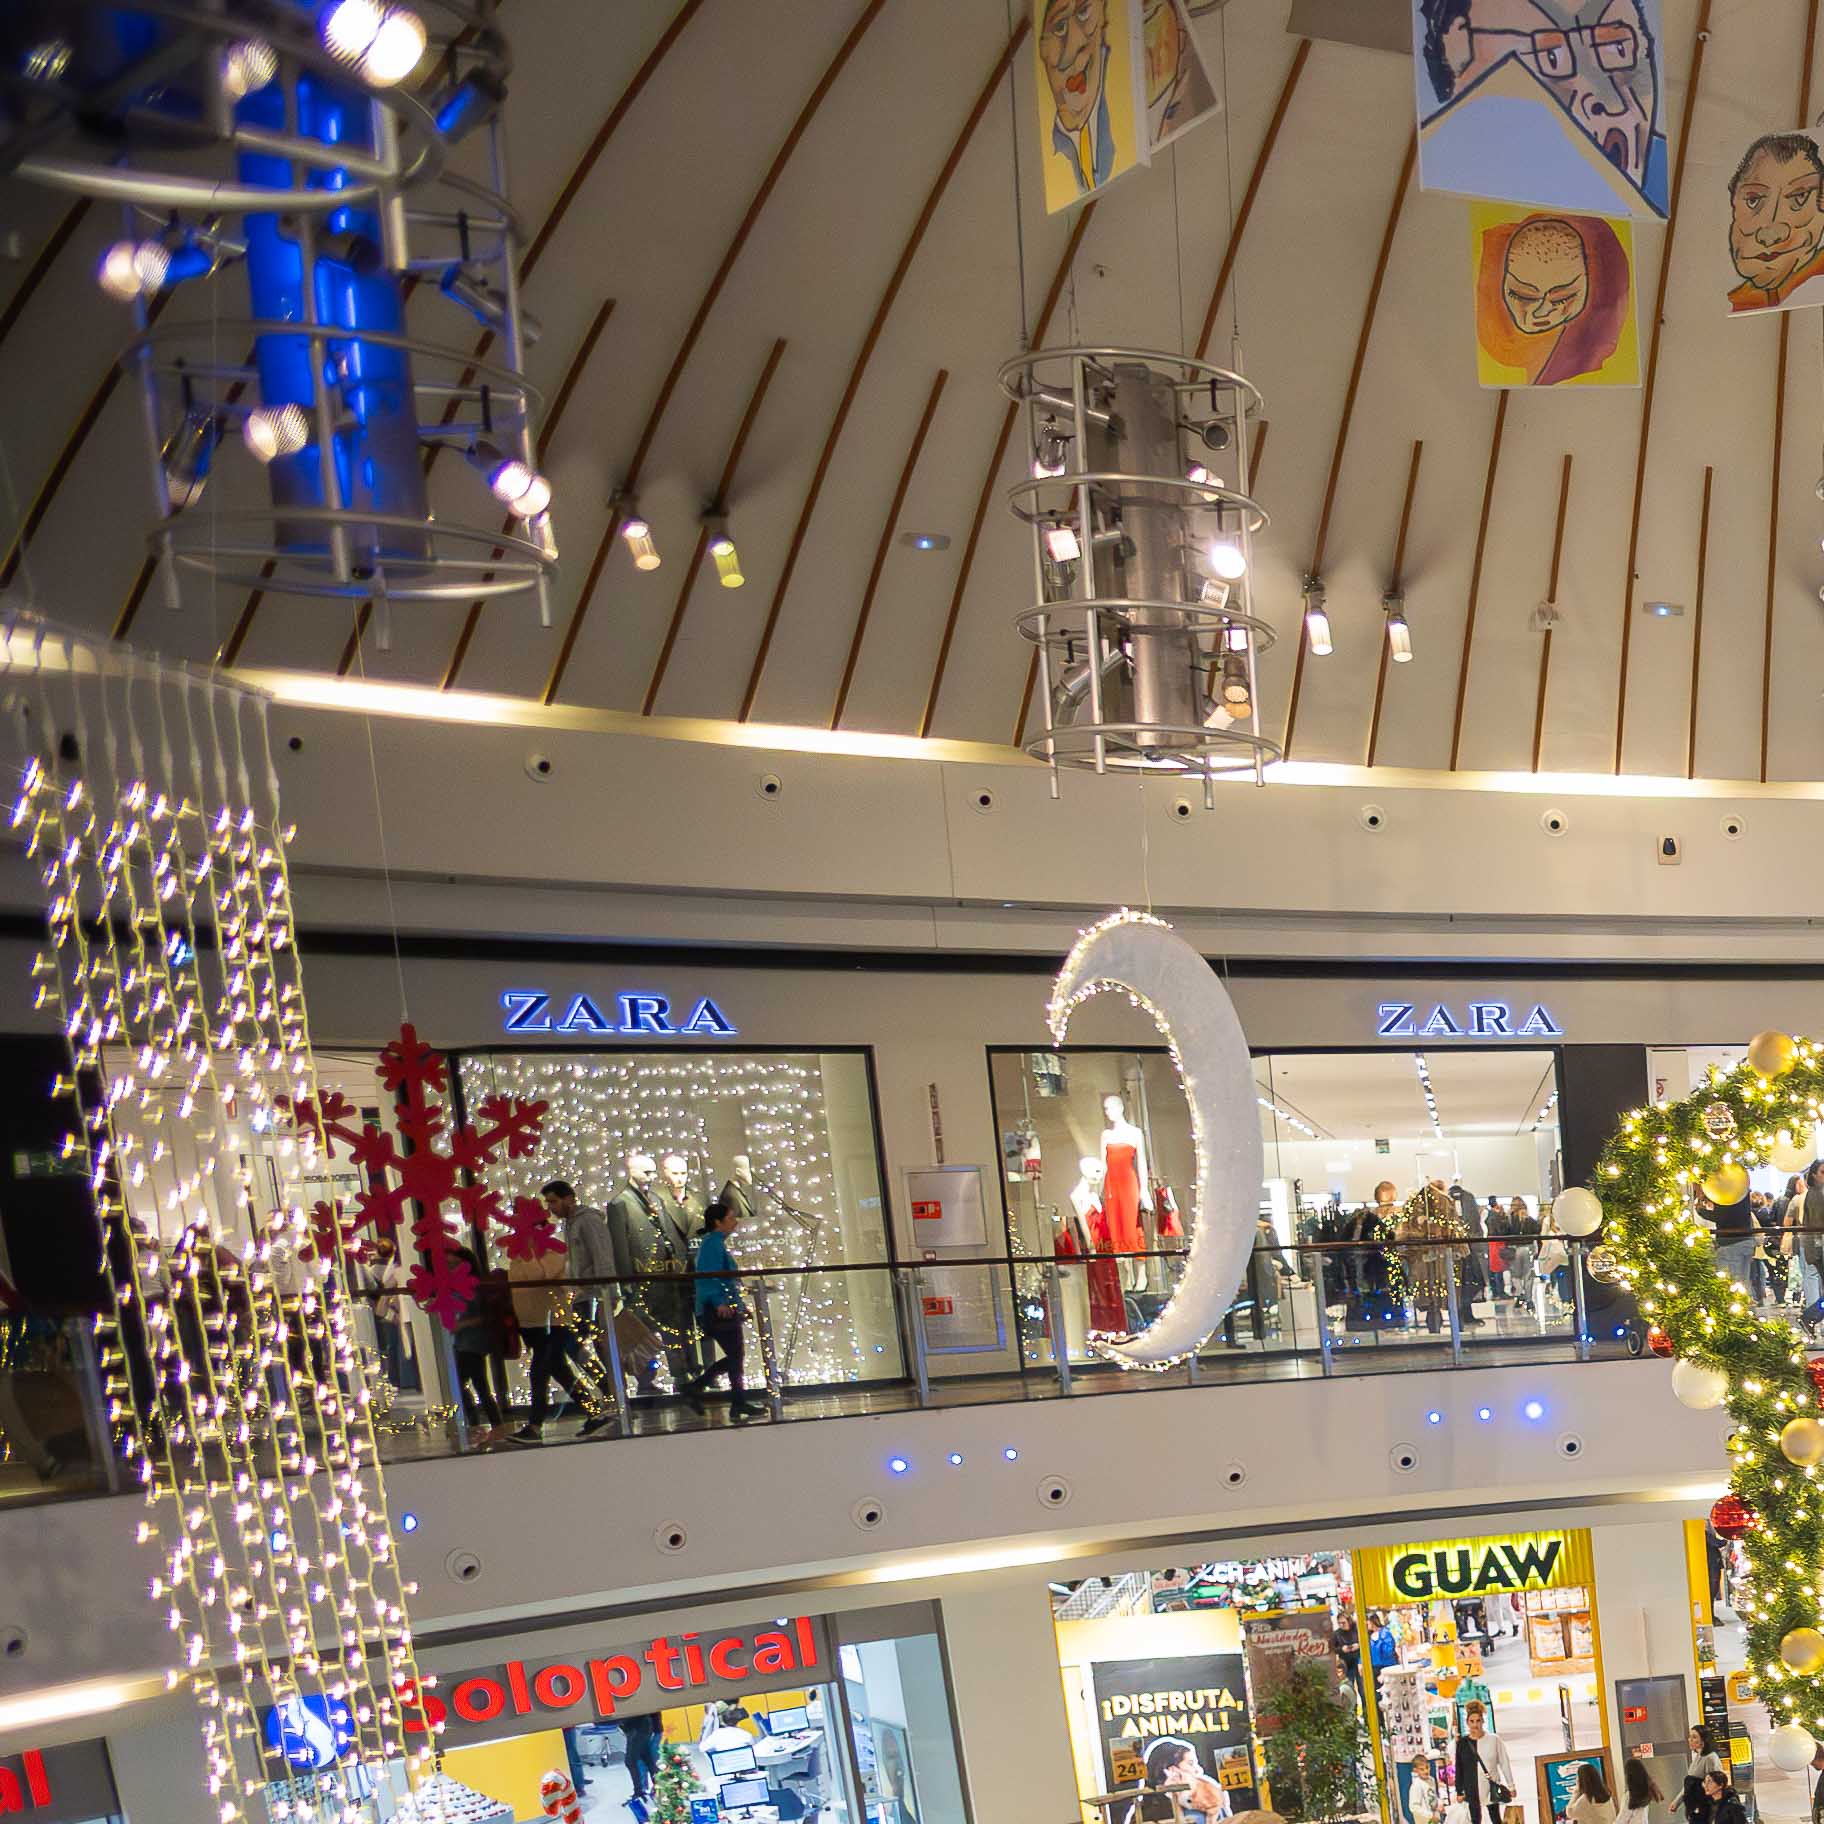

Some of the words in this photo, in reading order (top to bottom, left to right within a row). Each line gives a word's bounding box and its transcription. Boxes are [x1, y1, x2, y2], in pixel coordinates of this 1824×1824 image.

[504, 991, 737, 1034] ZARA
[1379, 1003, 1563, 1036] ZARA
[1393, 1540, 1562, 1597] GUAW
[1101, 1687, 1245, 1722] ¡DISFRUTA,
[1120, 1711, 1230, 1738] ANIMAL!
